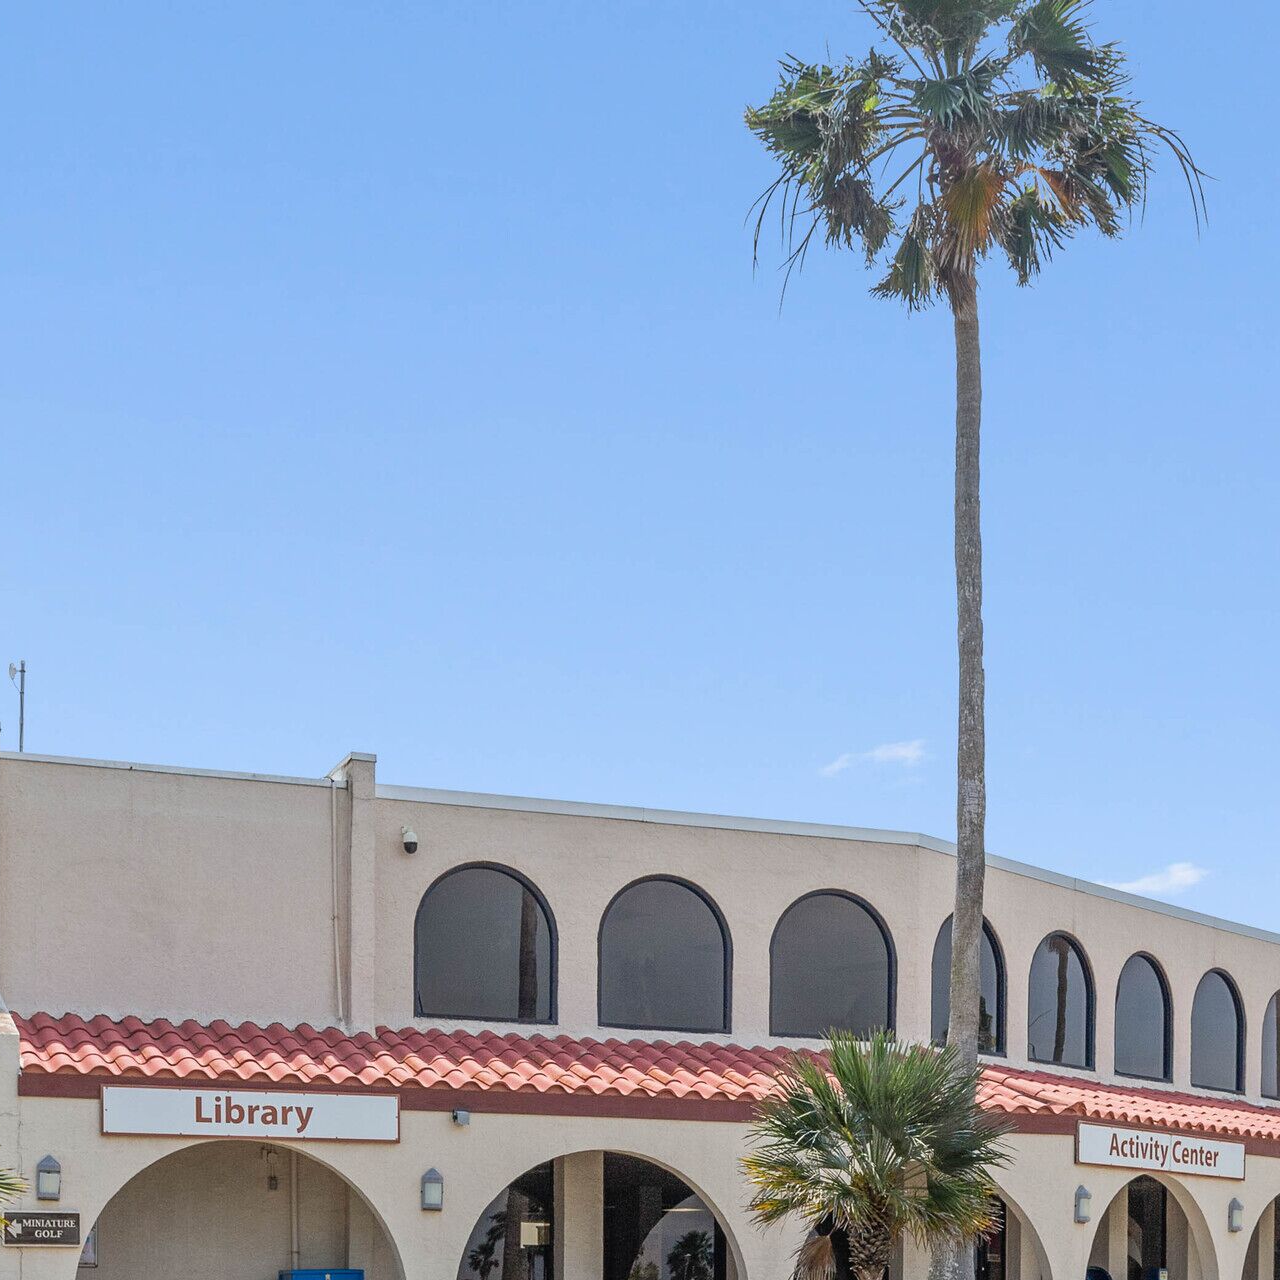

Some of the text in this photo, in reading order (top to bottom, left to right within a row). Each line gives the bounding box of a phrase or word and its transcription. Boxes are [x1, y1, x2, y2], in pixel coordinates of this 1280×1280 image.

[195, 1096, 314, 1133] Library
[1109, 1133, 1219, 1167] Activity Center
[22, 1219, 77, 1228] MINIATURE
[34, 1229, 64, 1238] GOLF
